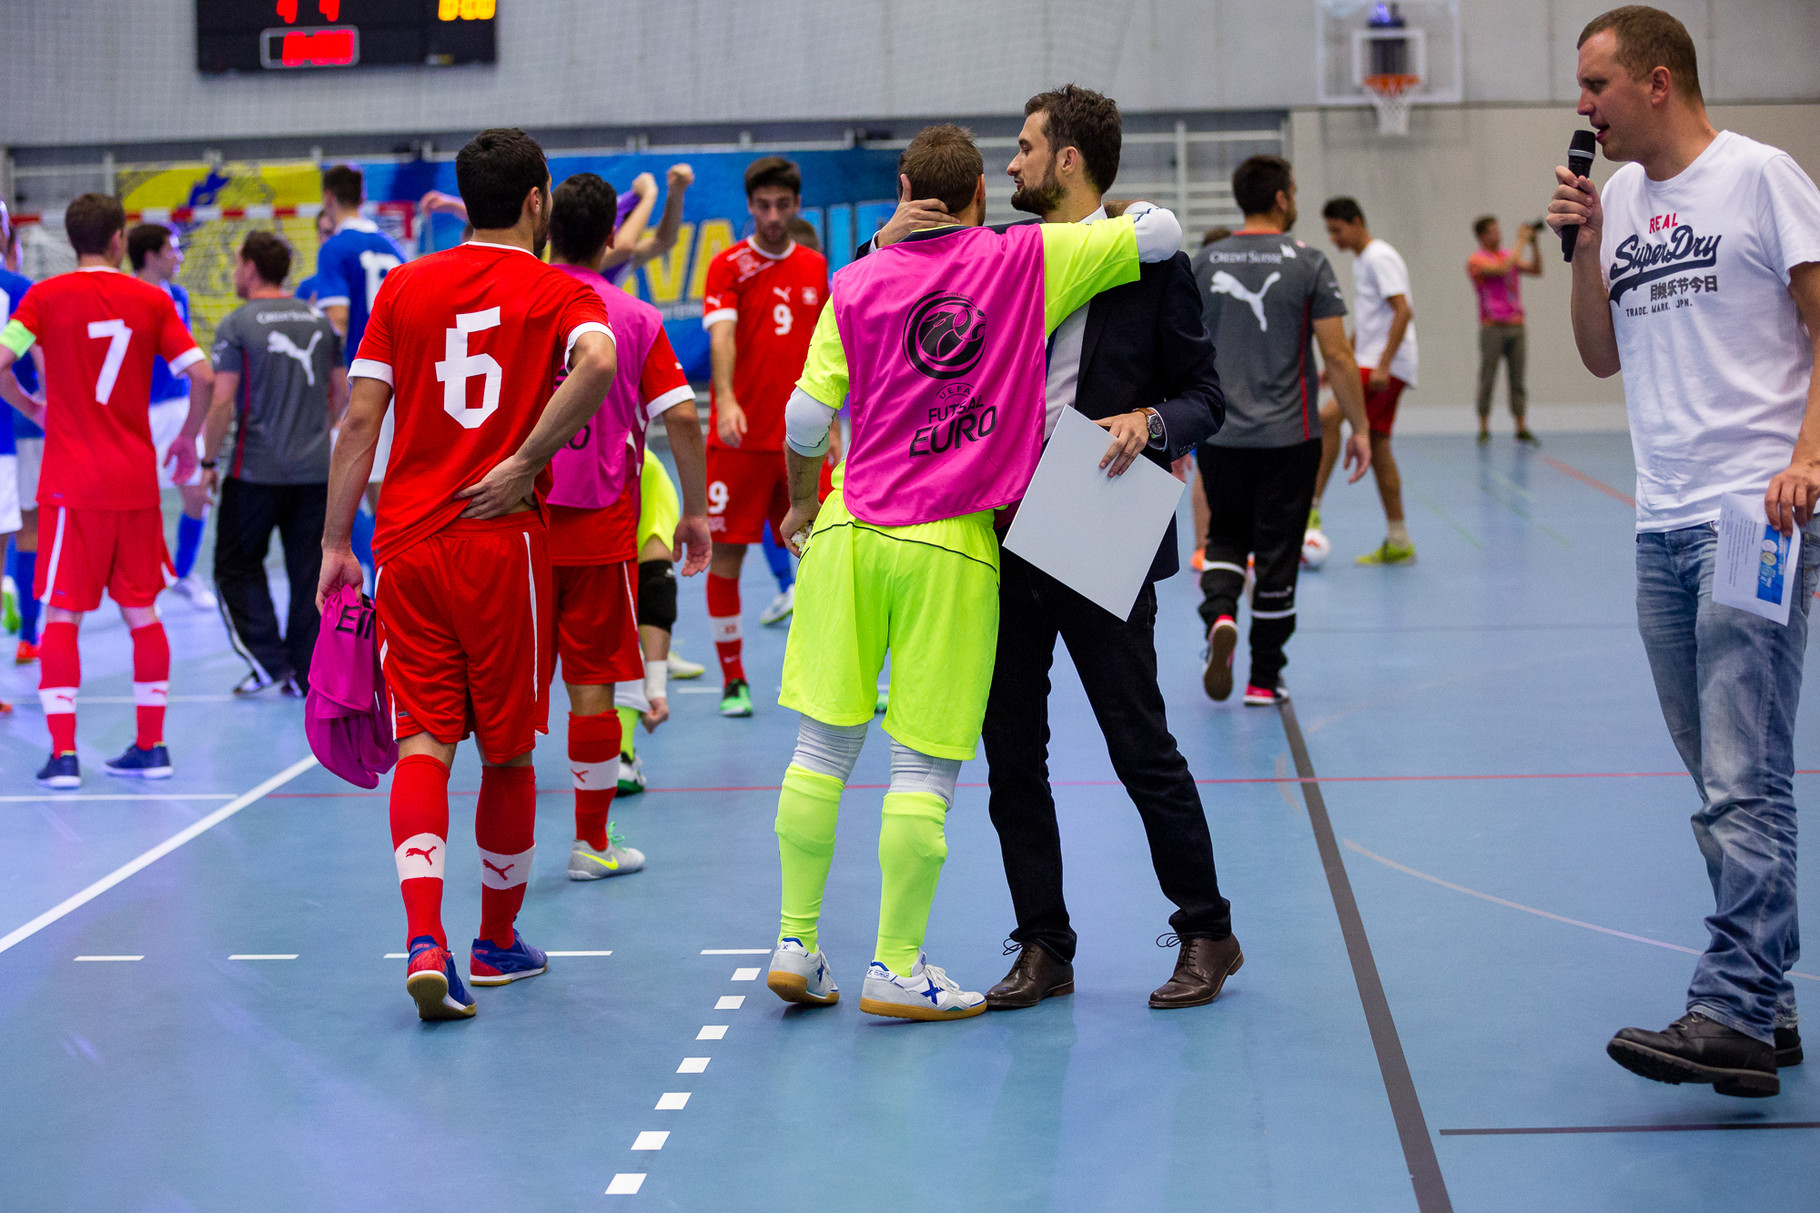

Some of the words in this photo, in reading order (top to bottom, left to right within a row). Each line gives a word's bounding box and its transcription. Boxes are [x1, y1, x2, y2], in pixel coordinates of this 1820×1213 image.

[1649, 213, 1679, 234] REAL
[1676, 298, 1693, 309] JPN.
[774, 304, 793, 335] 9
[87, 319, 133, 405] 7
[435, 306, 502, 429] 6
[938, 385, 972, 400] UEFA
[928, 395, 985, 424] FUTSAL
[909, 405, 998, 459] EURO
[708, 480, 729, 515] 9
